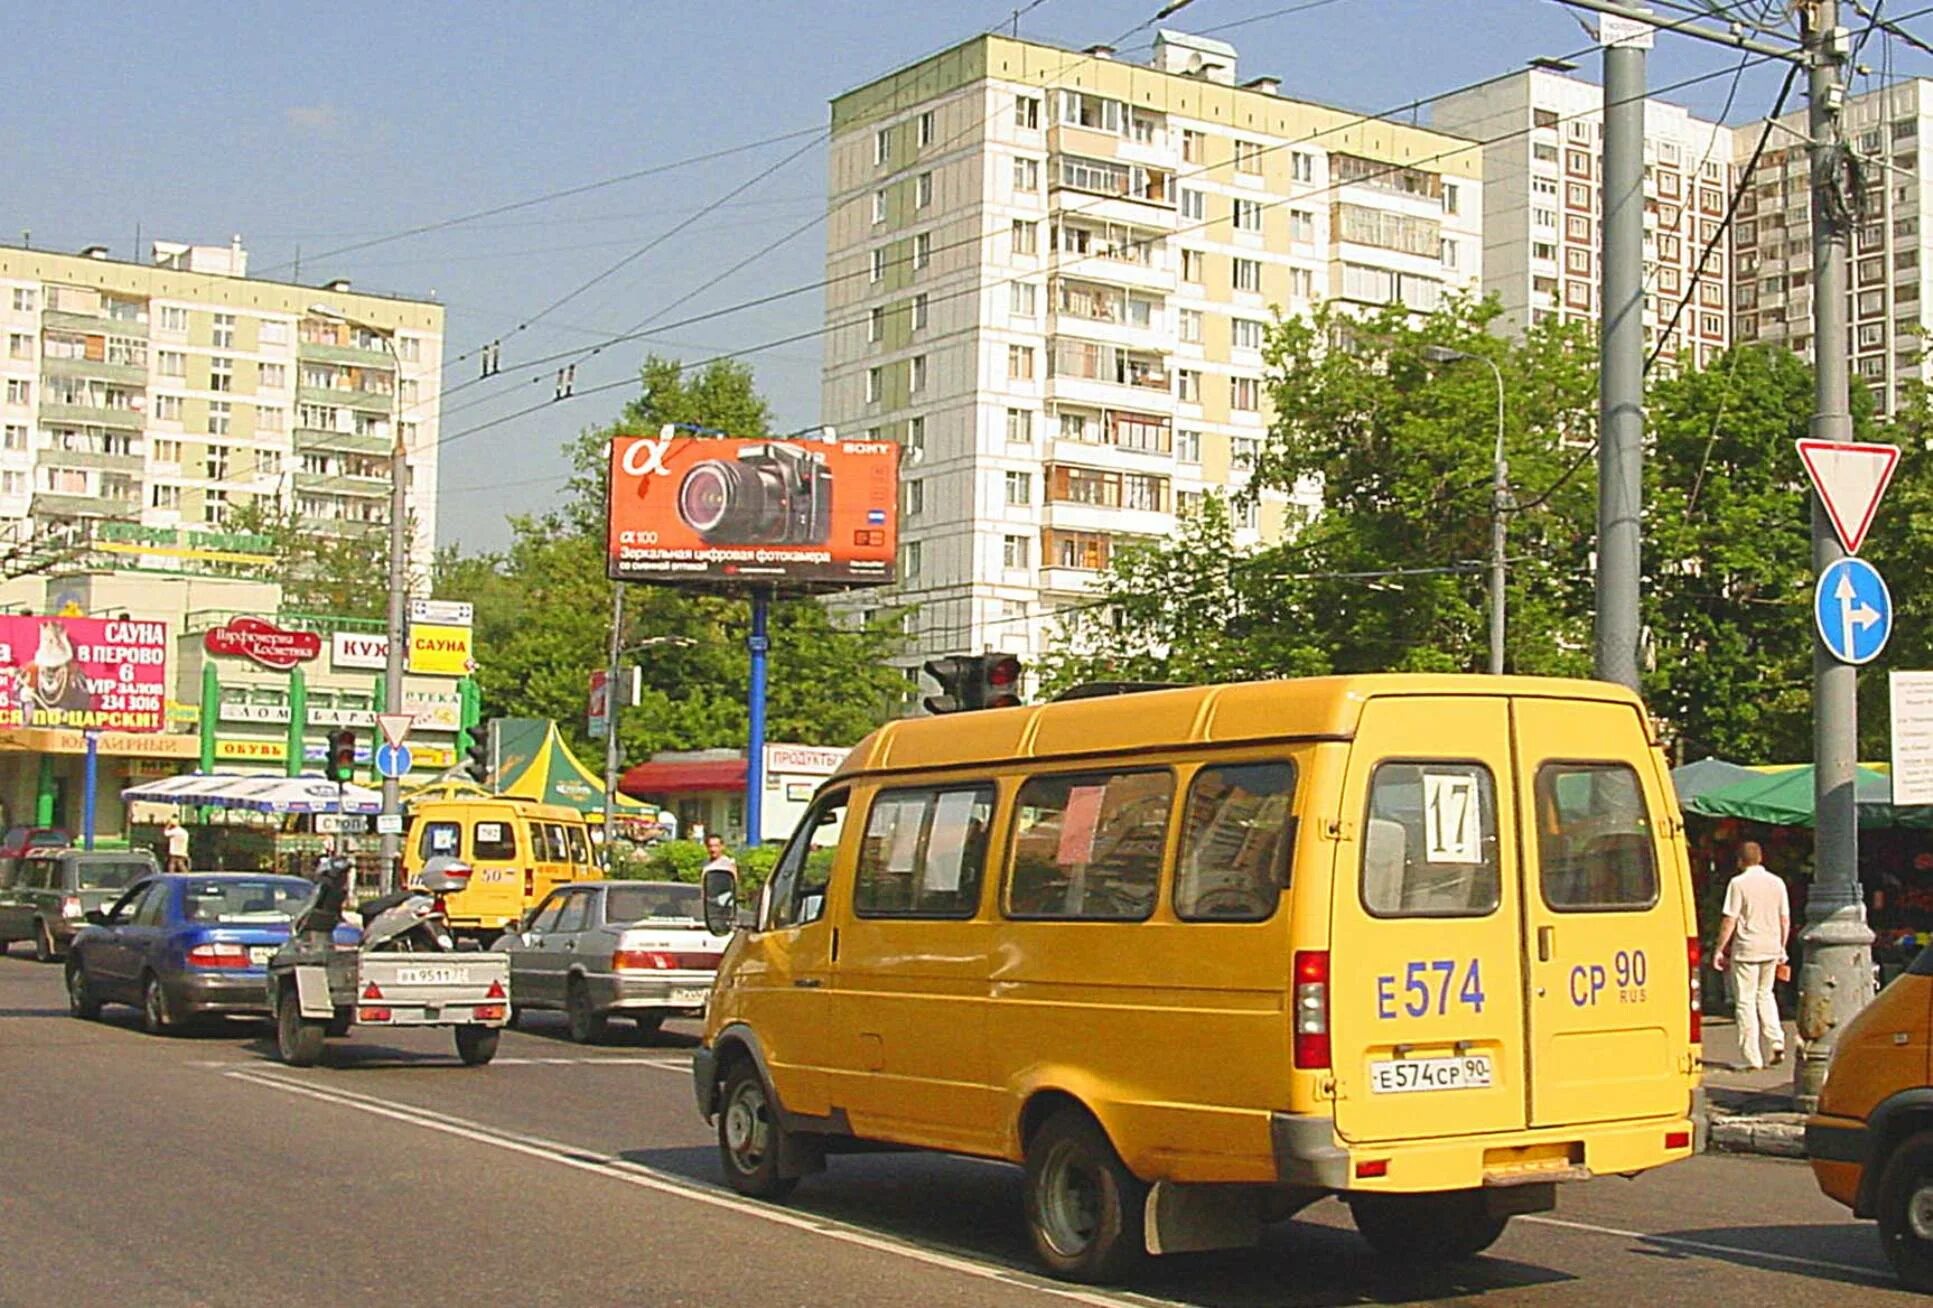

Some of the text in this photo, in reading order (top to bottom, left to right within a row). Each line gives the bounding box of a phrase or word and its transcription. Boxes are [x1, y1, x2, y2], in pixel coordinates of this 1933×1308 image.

[106, 623, 164, 644] САУНА
[253, 641, 313, 657] Косметика
[415, 638, 466, 652] САУНА
[78, 645, 163, 664] В ПЕРОВО
[119, 663, 134, 682] 6
[87, 679, 115, 694] VIP
[101, 694, 125, 710] 234
[405, 692, 458, 704] ПТЕКА
[62, 736, 177, 752] ЮЛИРНЫЙ
[224, 744, 281, 756] ОБУВЬ
[1431, 783, 1469, 853] 17
[1615, 950, 1646, 987] 90
[1620, 989, 1647, 1003] RUS
